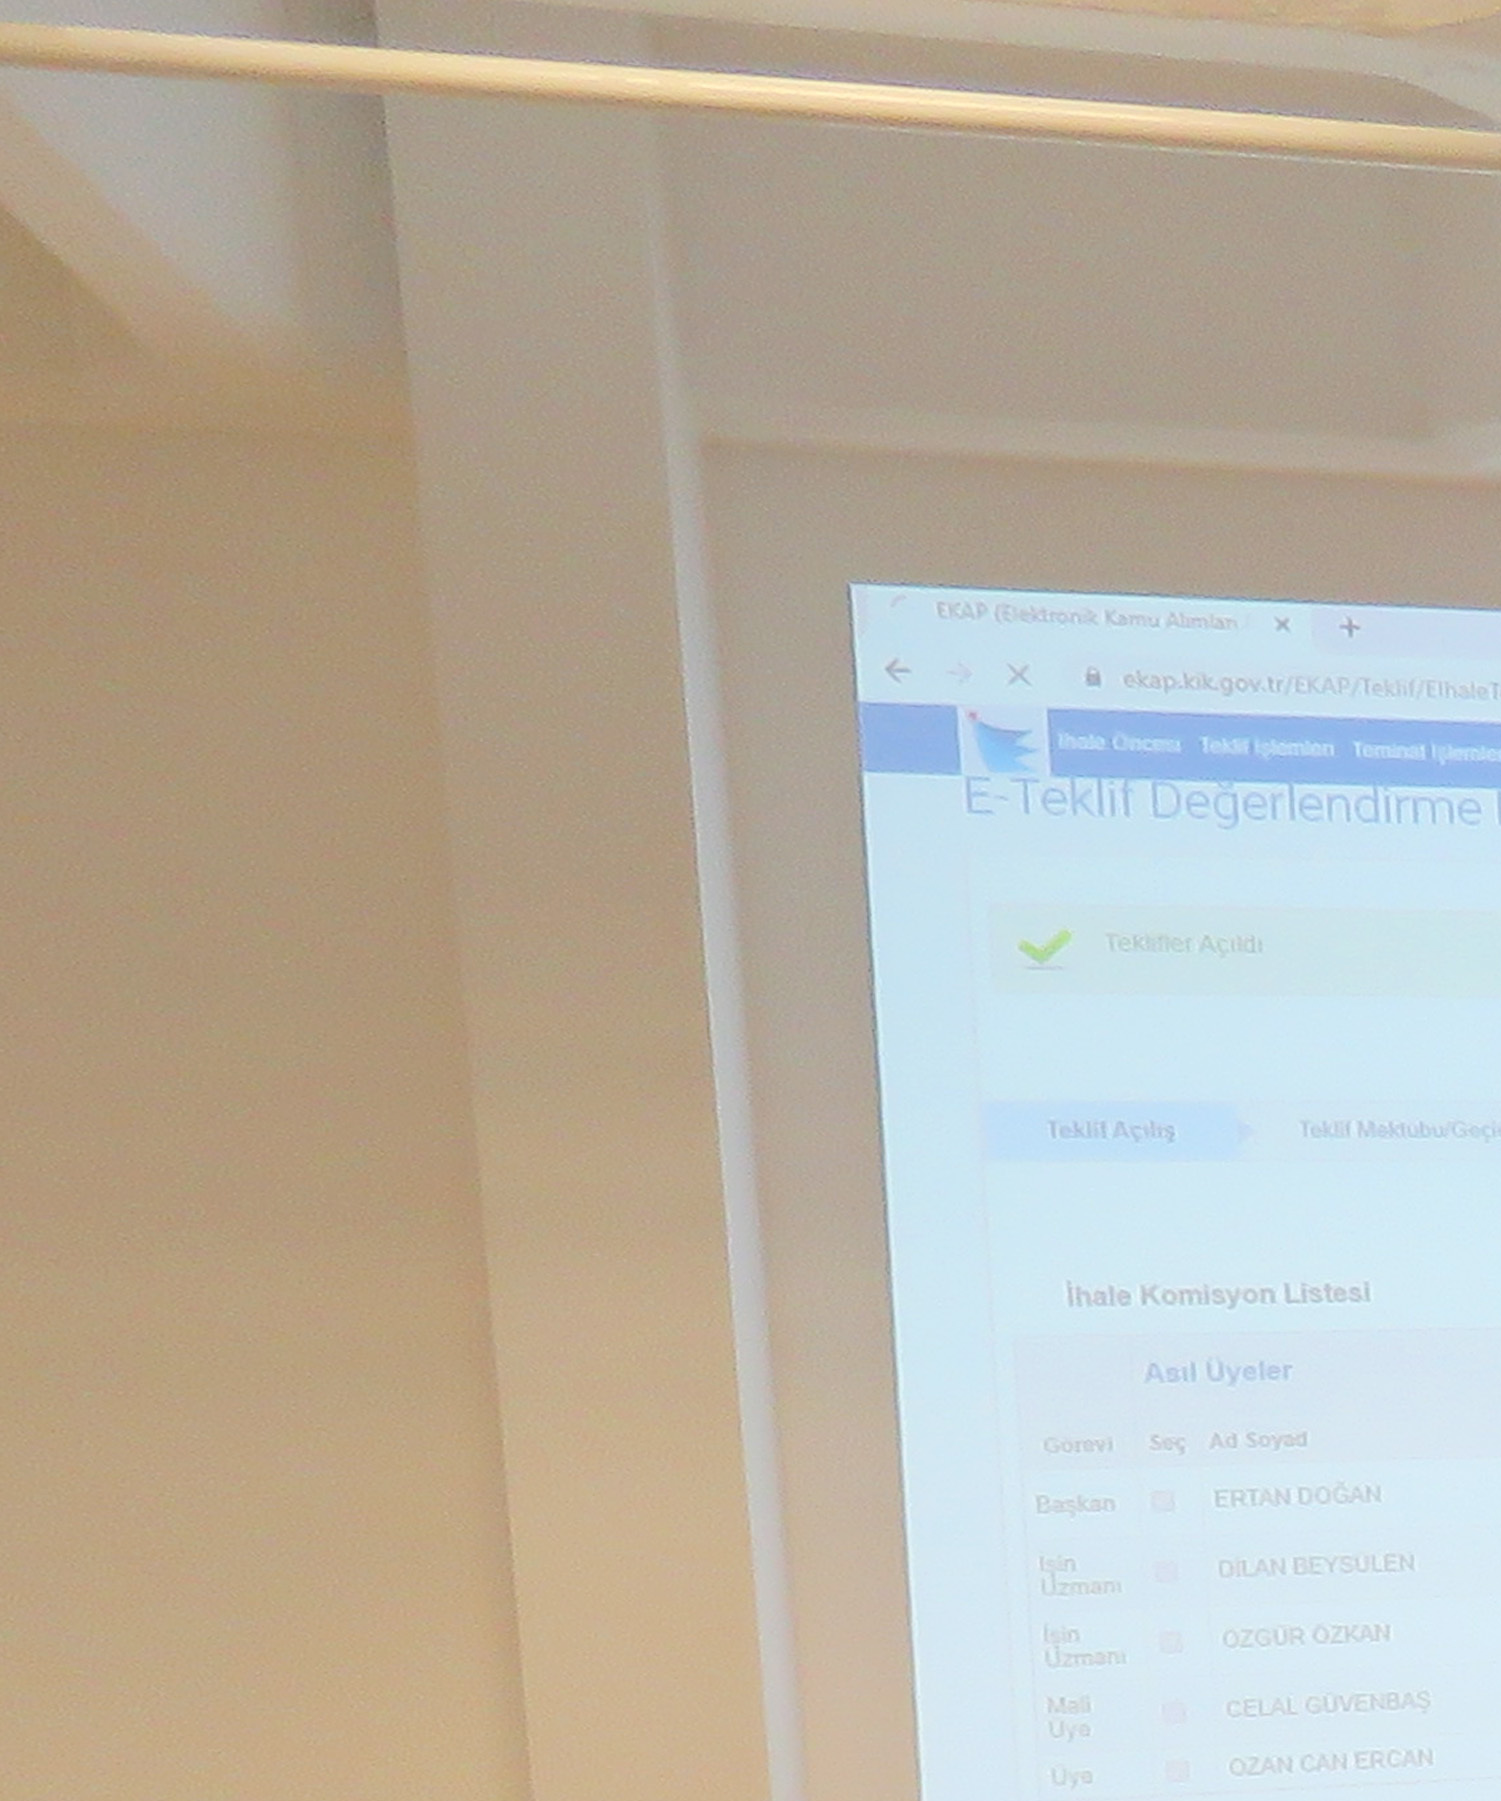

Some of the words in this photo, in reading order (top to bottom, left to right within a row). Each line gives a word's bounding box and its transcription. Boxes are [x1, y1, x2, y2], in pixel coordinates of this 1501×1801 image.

[937, 603, 988, 621] EKAP
[994, 604, 1099, 627] (Elektronik
[1104, 609, 1161, 627] Kamu
[965, 776, 1132, 816] E-Teklif
[1150, 779, 1482, 830] Değerlendirme
[1105, 933, 1193, 954] Teklifler
[1047, 1119, 1108, 1140] Teklif
[1299, 1119, 1351, 1140] Teklif
[1066, 1280, 1131, 1307] İhale
[1141, 1282, 1277, 1309] Komisyon
[1284, 1281, 1371, 1305] Listesi
[1206, 1357, 1293, 1387] Üyeler
[1208, 1433, 1237, 1450] Ad
[1246, 1432, 1308, 1452] Soyad
[1037, 1494, 1115, 1517] Başkan
[1215, 1487, 1290, 1508] ERTAN
[1298, 1482, 1382, 1506] DOĞAN
[1226, 1696, 1297, 1718] CELAL
[1300, 1753, 1349, 1773] CAN
[1355, 1747, 1434, 1771] ERCAN
